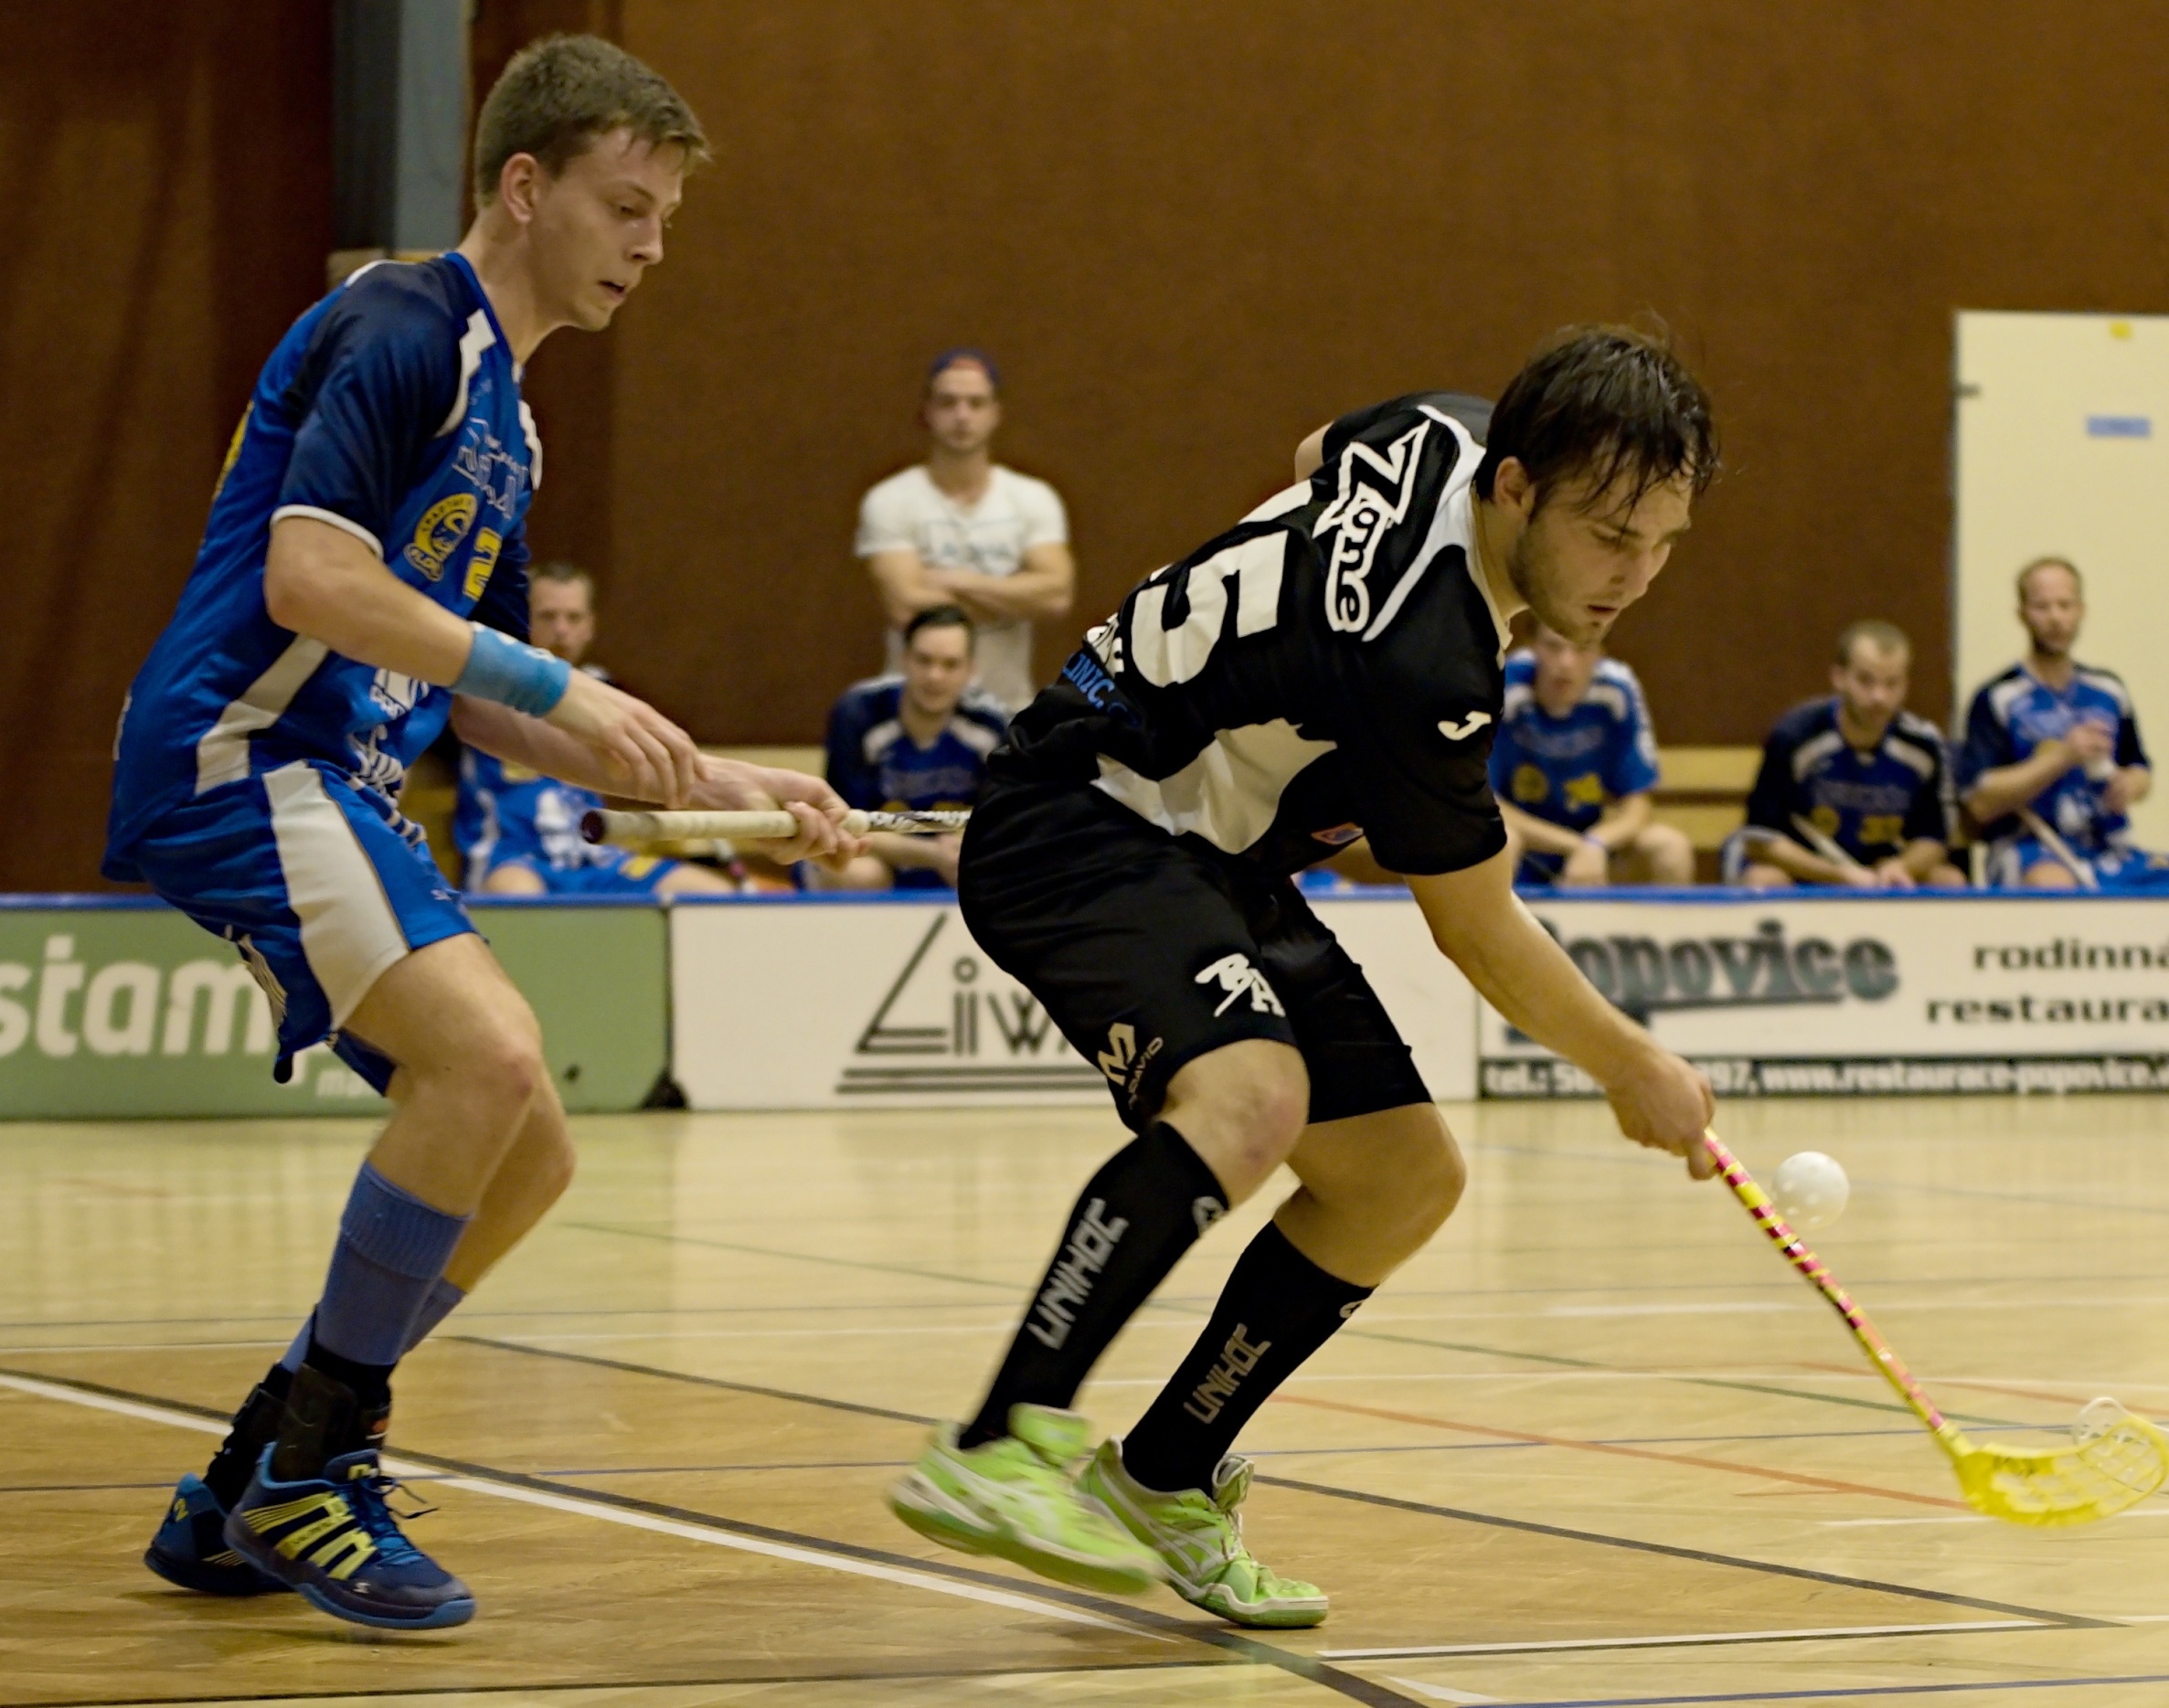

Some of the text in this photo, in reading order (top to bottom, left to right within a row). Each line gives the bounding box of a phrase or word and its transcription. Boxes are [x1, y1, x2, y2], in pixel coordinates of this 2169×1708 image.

[1131, 479, 1313, 687] 5
[0, 934, 333, 1087] stam
[1505, 917, 1898, 1044] opovice
[1026, 1197, 1130, 1350] UNIHOC
[1183, 1323, 1272, 1424] UNIHOC
